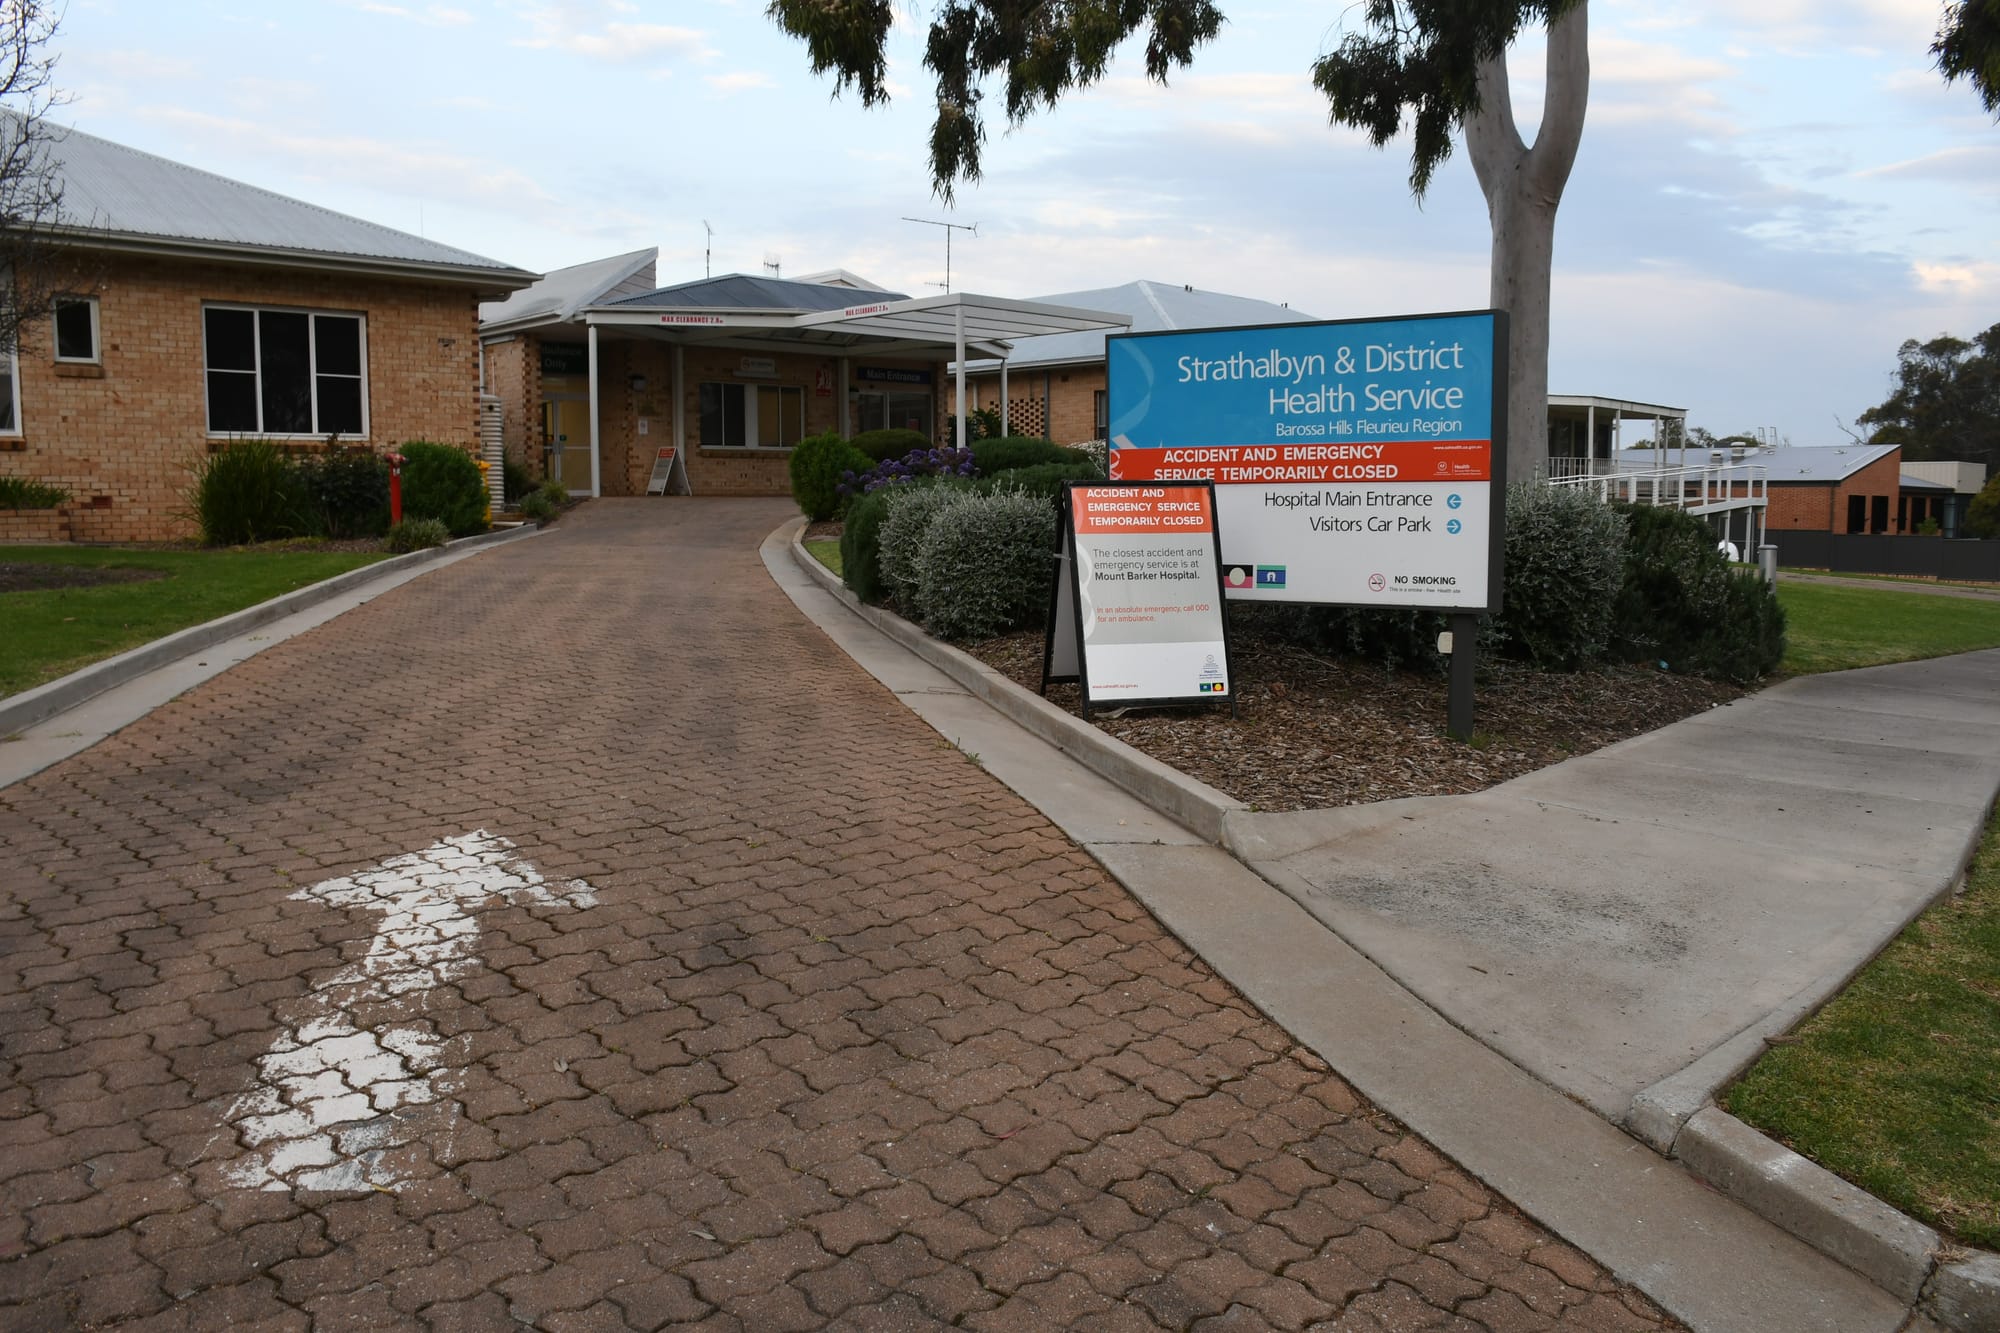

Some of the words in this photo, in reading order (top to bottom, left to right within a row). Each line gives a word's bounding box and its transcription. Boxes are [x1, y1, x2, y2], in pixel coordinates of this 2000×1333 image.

[1177, 347, 1326, 386] Strathalbyn
[1334, 346, 1356, 374] &
[1365, 340, 1464, 373] District
[866, 368, 886, 379] Main
[887, 370, 921, 382] Entrance
[1269, 386, 1356, 415] Health
[1364, 382, 1464, 412] Service
[1276, 421, 1326, 437] Barossa
[1328, 420, 1353, 436] Hills
[1356, 418, 1410, 435] Fleurieu
[1412, 417, 1462, 437] Region
[1163, 448, 1240, 464] ACCIDENT
[1242, 447, 1277, 462] AND
[1283, 444, 1384, 461] EMERGENCY
[1153, 466, 1216, 482] SERVICE
[1221, 465, 1329, 481] TEMPORARILY
[1332, 463, 1399, 480] CLOSED
[1087, 488, 1139, 499] ACCIDENT
[1142, 488, 1165, 498] AND
[1087, 502, 1152, 513] EMERGENCY
[1157, 502, 1201, 512] SERVICE
[1264, 491, 1321, 511] Hospital
[1325, 491, 1362, 508] Main
[1366, 491, 1434, 507] Entrance
[1088, 516, 1161, 527] TEMPORARILY
[1162, 516, 1204, 526] CLOSED
[1309, 516, 1363, 533] Visitors
[1367, 517, 1393, 533] Car
[1397, 516, 1432, 533] Park
[1093, 548, 1110, 558] The
[1112, 548, 1145, 558] closest
[1146, 548, 1184, 557] accident
[1186, 547, 1203, 557] and
[1094, 561, 1145, 573] emergency
[1146, 560, 1179, 569] service
[1181, 560, 1188, 569] is
[1190, 560, 1199, 569] at
[1095, 571, 1125, 581] Mount
[1127, 571, 1157, 581] Barker
[1159, 570, 1200, 582] Hospital.
[1394, 575, 1409, 584] NO
[1412, 575, 1456, 586] SMOKING
[1115, 605, 1143, 614] absolute
[1183, 604, 1194, 612] call
[1195, 604, 1210, 612] 000
[1097, 615, 1106, 623] for
